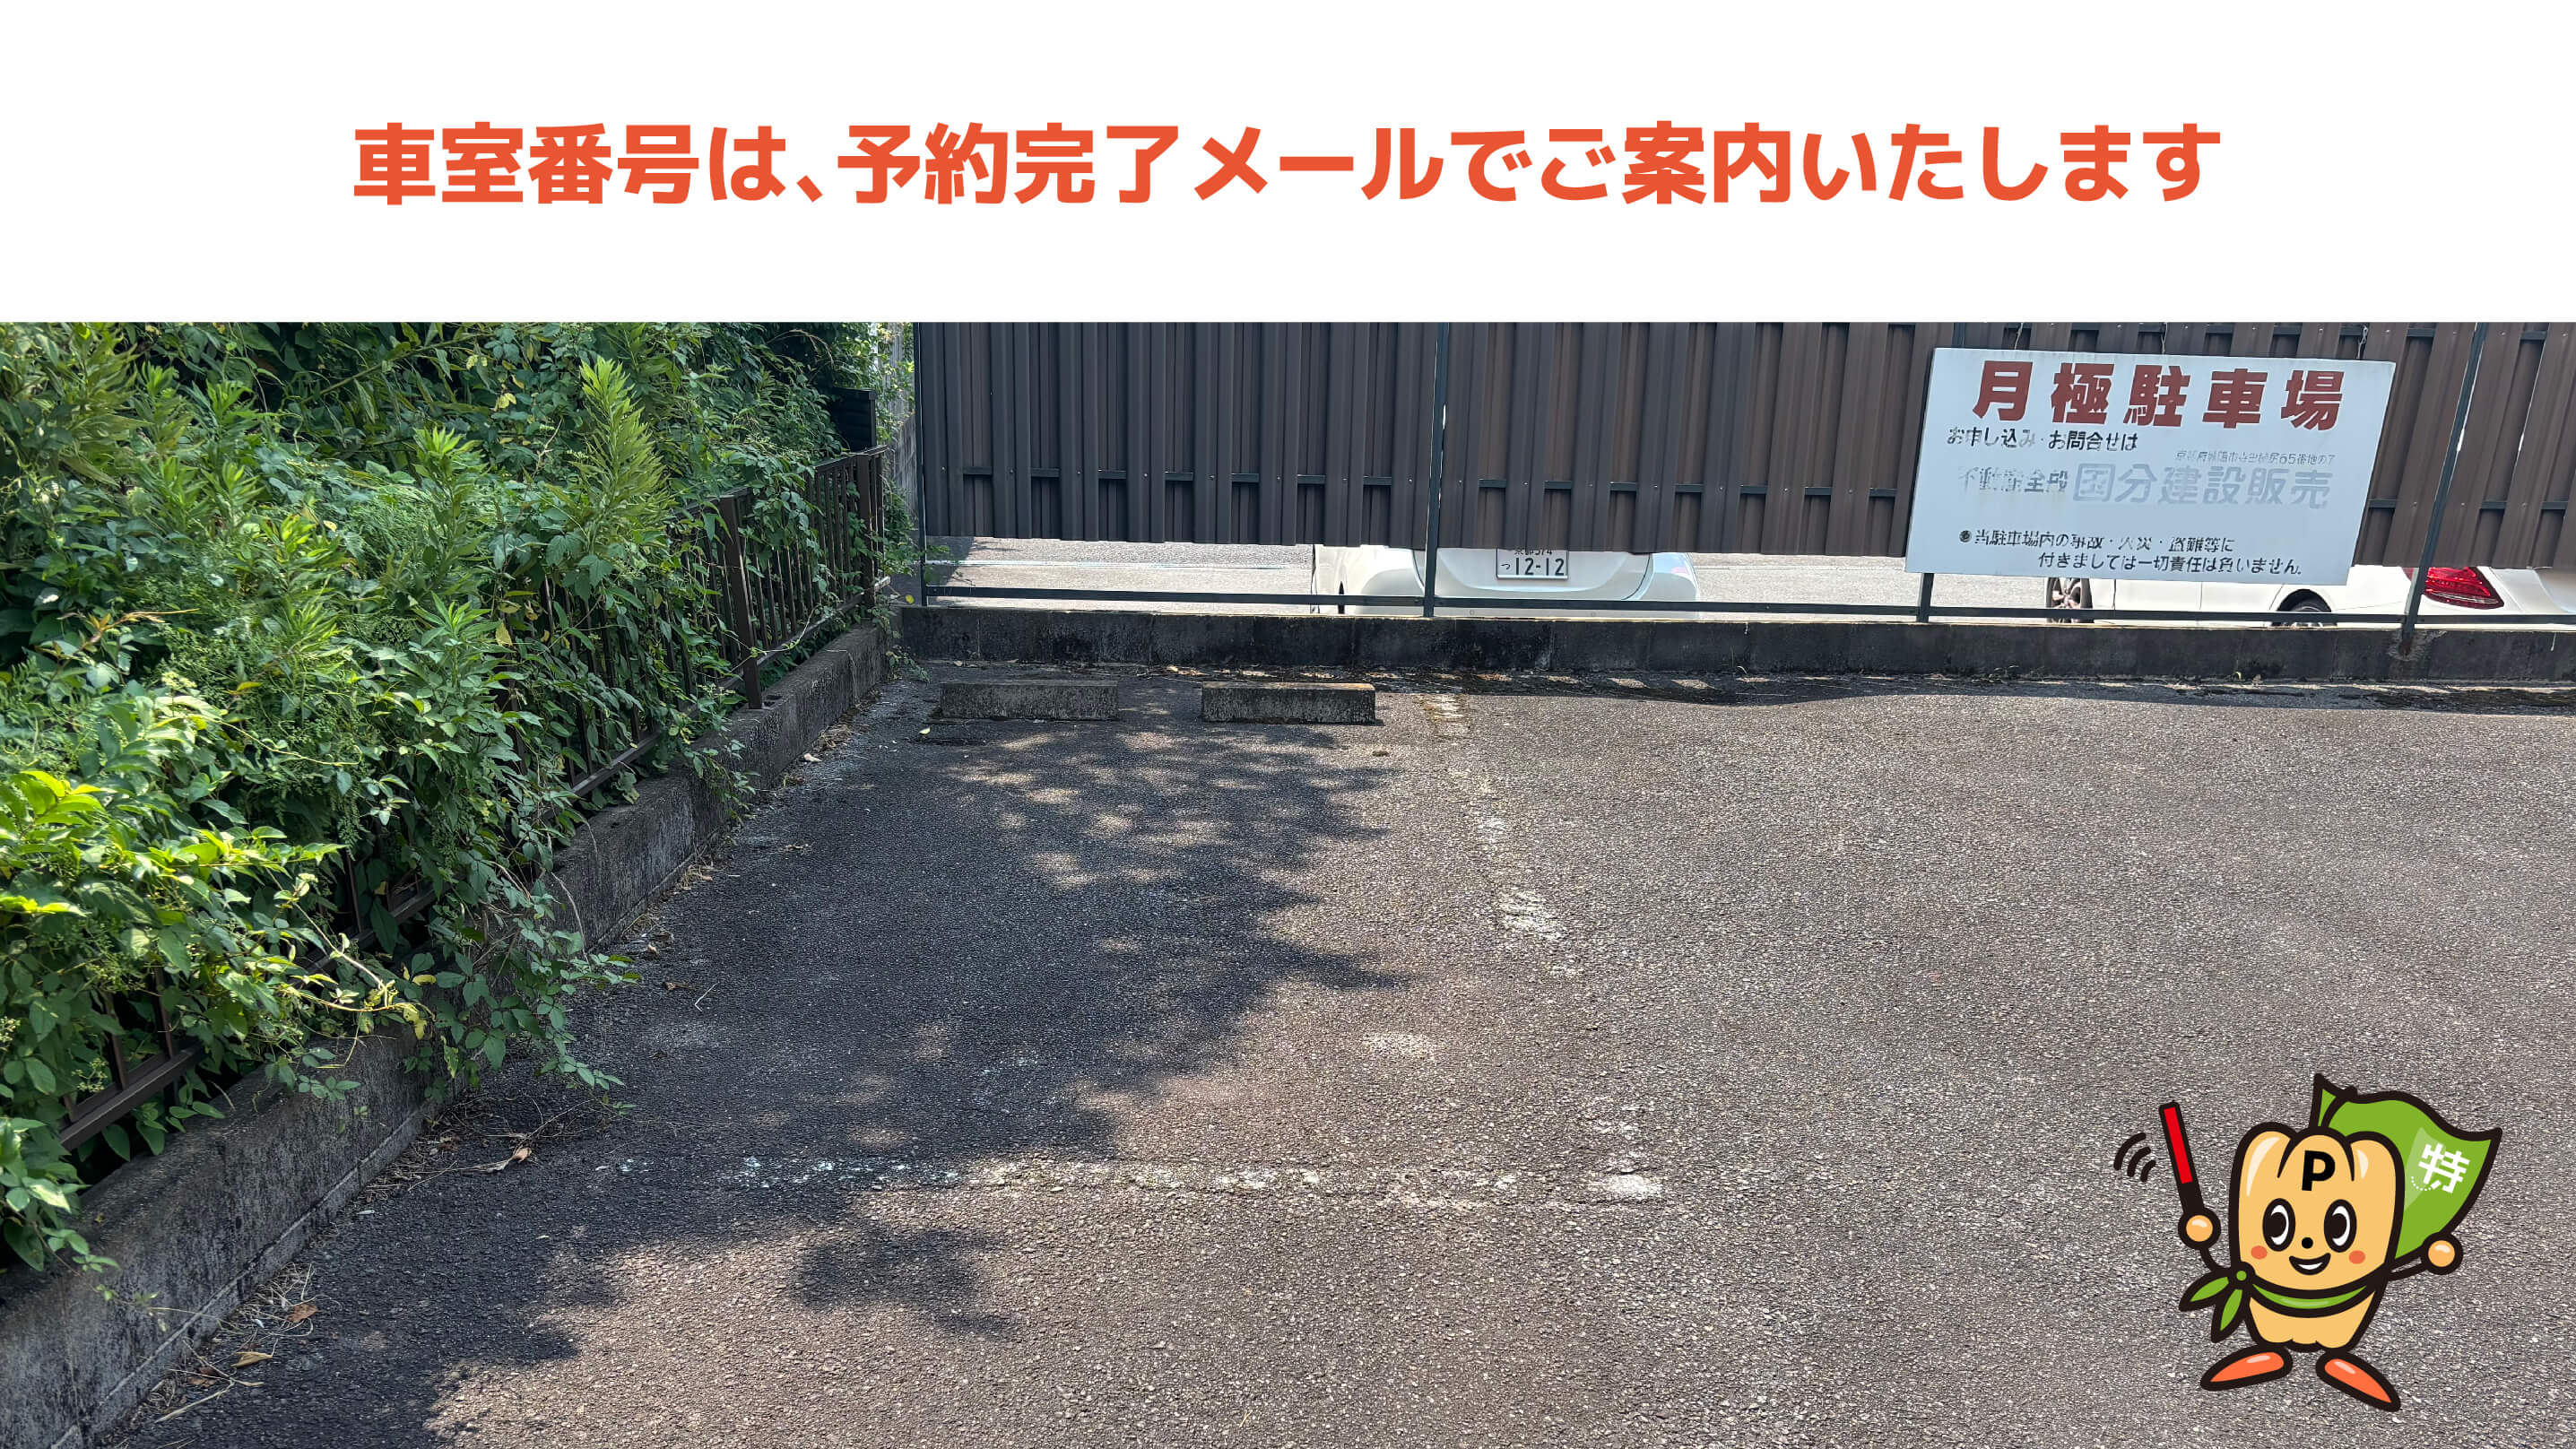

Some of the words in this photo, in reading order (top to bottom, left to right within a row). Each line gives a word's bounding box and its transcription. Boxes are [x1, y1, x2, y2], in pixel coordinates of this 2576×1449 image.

[1973, 360, 2345, 431] 月極駐車場
[1958, 466, 2069, 493] 不動全般
[1515, 557, 1565, 576] 12-12
